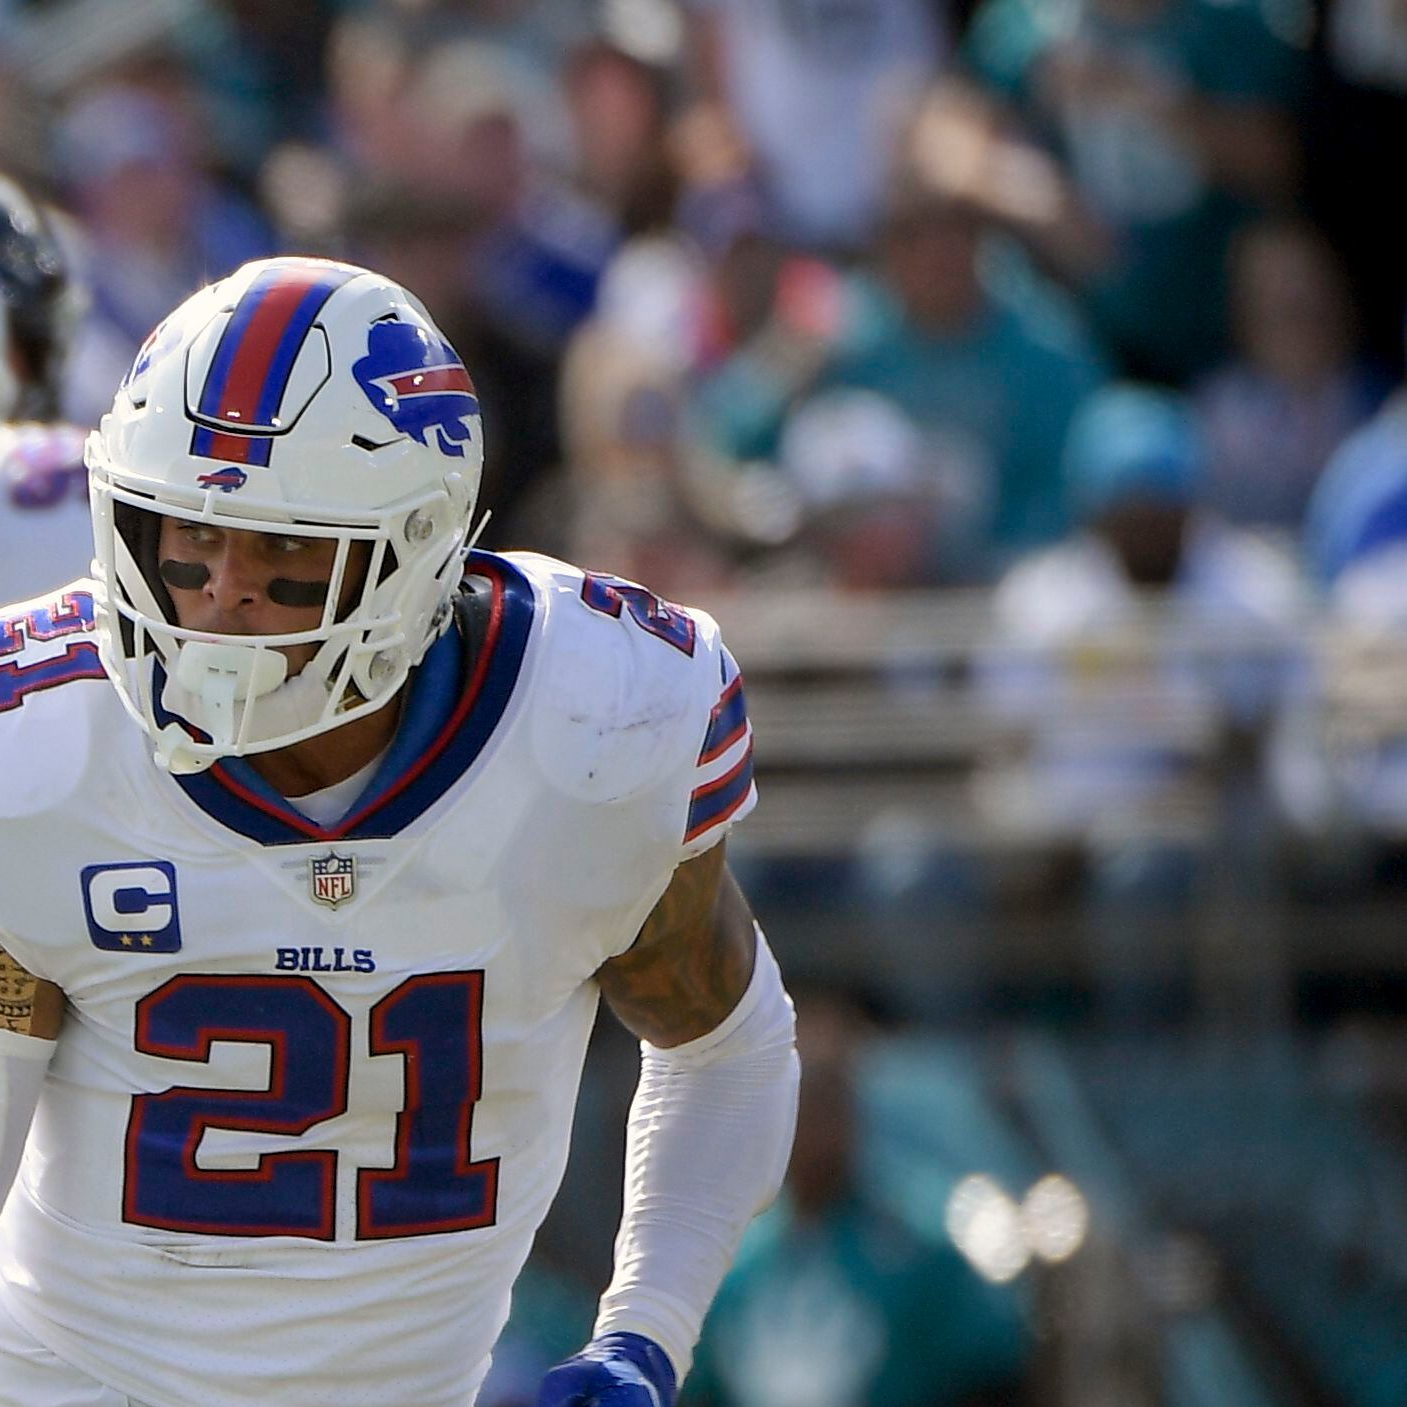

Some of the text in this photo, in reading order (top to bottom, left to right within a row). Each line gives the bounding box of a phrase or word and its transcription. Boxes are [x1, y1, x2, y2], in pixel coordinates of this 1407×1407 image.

[89, 867, 173, 933] C
[316, 875, 351, 899] NFL
[274, 946, 377, 974] BILLS
[122, 969, 500, 1242] 21
